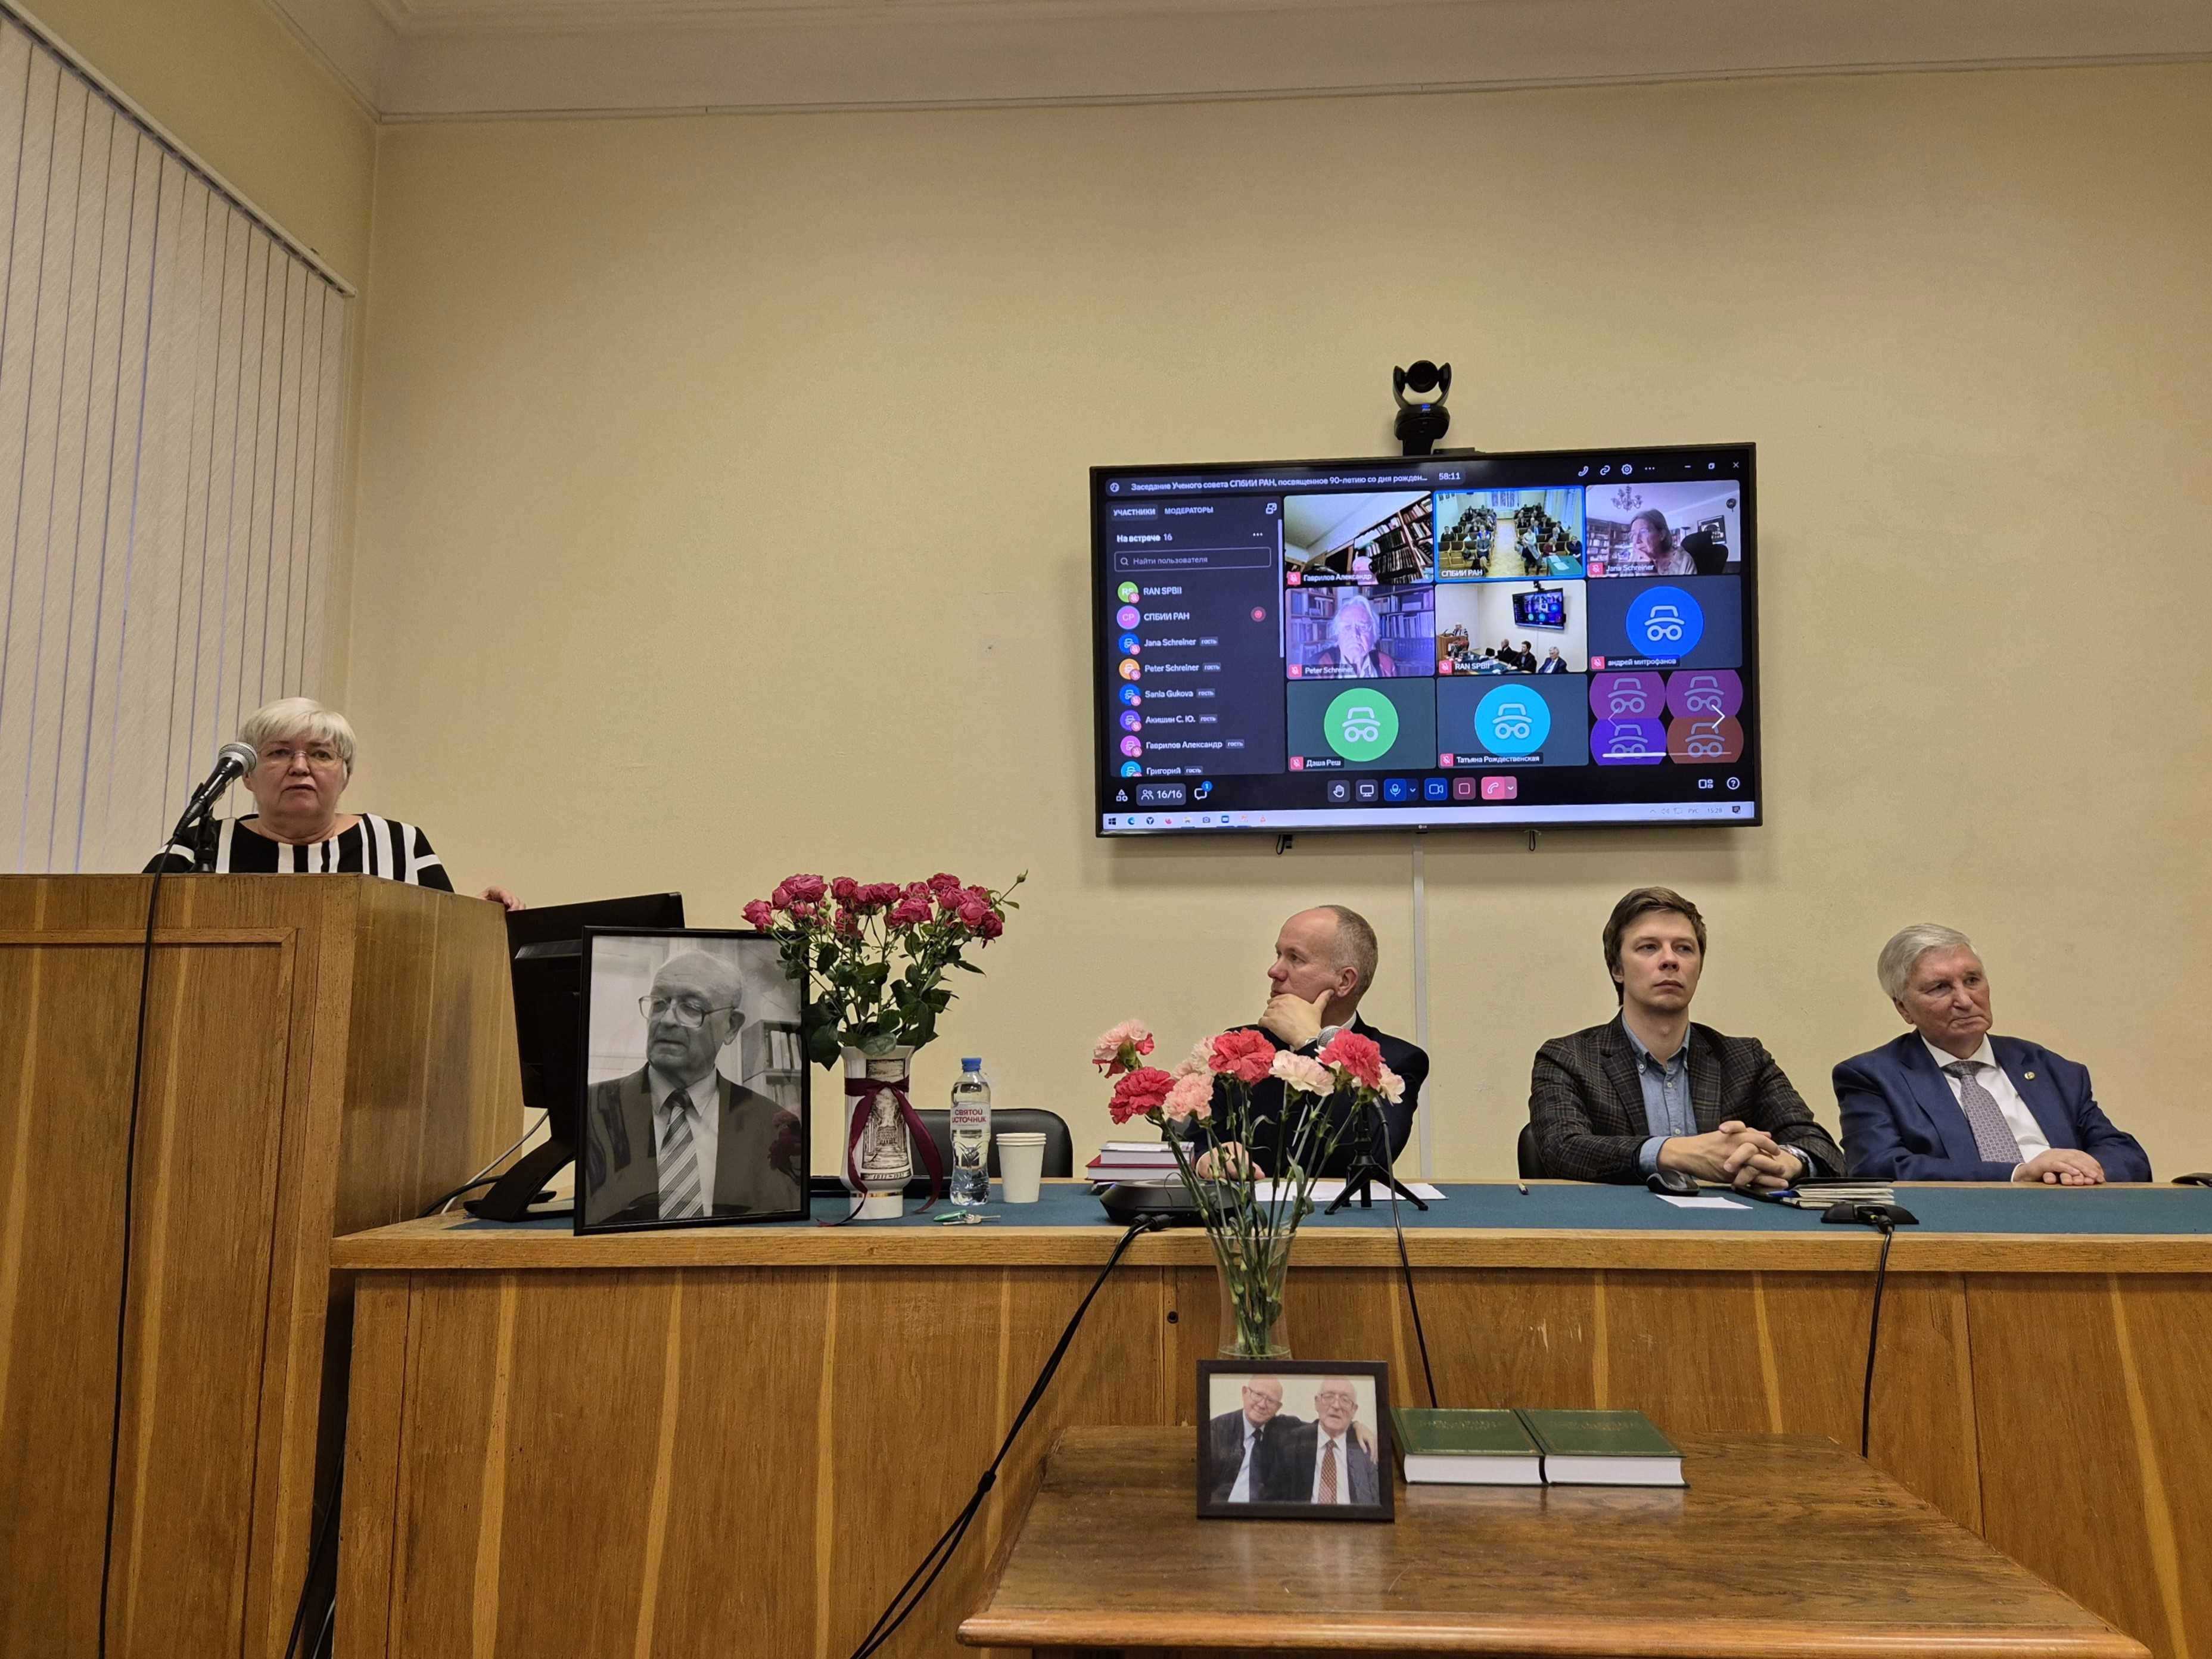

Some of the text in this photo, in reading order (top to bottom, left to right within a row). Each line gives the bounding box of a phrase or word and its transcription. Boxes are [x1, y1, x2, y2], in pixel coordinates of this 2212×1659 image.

[1131, 483, 1171, 491] Заседание
[1172, 481, 1202, 490] Ученого
[1258, 479, 1277, 487] РАН,
[1329, 476, 1366, 485] 90-летию
[1113, 508, 1156, 516] УЧАСТНИКИ
[1164, 506, 1214, 515] МОДЕРАТОРЫ
[1129, 535, 1161, 543] встрече
[1163, 533, 1172, 541] 16
[1133, 556, 1208, 565] Найти пользователя
[1303, 573, 1372, 583] Гаврилов Александр
[1143, 587, 1161, 595] RAN
[1173, 612, 1190, 621] РАН
[1144, 638, 1196, 647] Jana Schreiner
[1455, 662, 1470, 670] RAN
[1607, 658, 1633, 667] андрей
[1144, 664, 1199, 673] Peter Schreiner
[1305, 665, 1354, 674] Peter Schreiner
[1166, 689, 1193, 698] Gukova
[1146, 740, 1222, 750] Гаврилов Александр
[1306, 759, 1325, 768] Даша
[1457, 755, 1540, 764] Татьяна Рождественская
[1146, 767, 1181, 776] Григорий
[1157, 789, 1183, 799] 16/16
